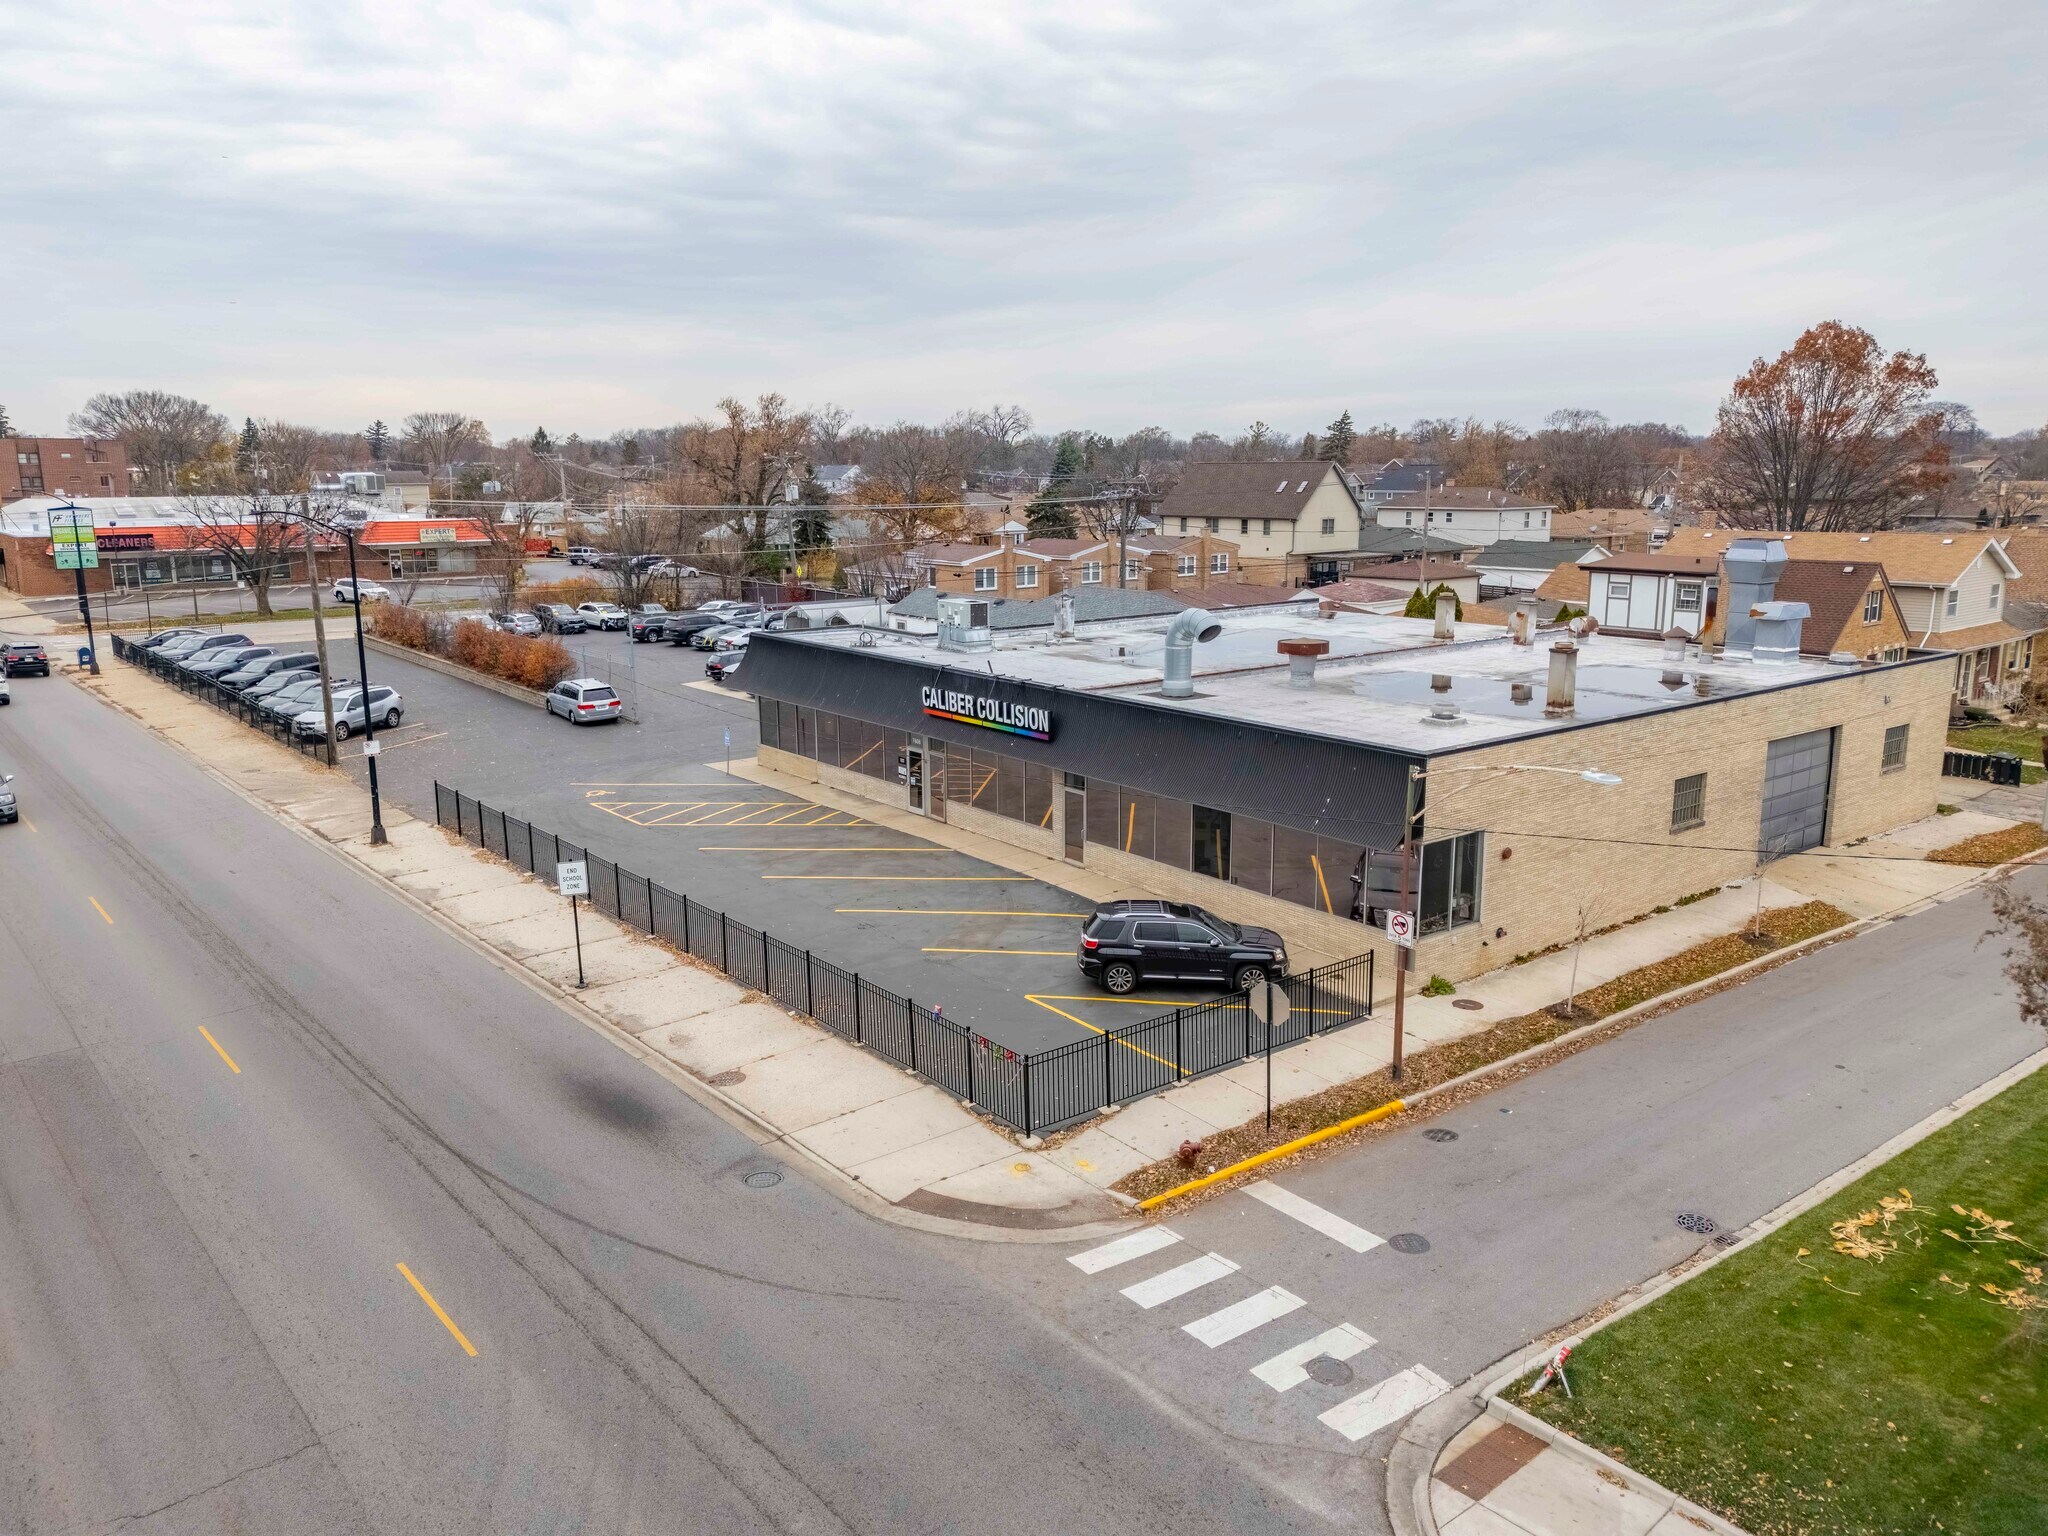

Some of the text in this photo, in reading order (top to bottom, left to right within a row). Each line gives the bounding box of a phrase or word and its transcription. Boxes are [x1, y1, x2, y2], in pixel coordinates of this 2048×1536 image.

[97, 537, 154, 548] CLEANERS
[922, 686, 1049, 732] CALIBER COLLISION
[566, 867, 577, 875] END
